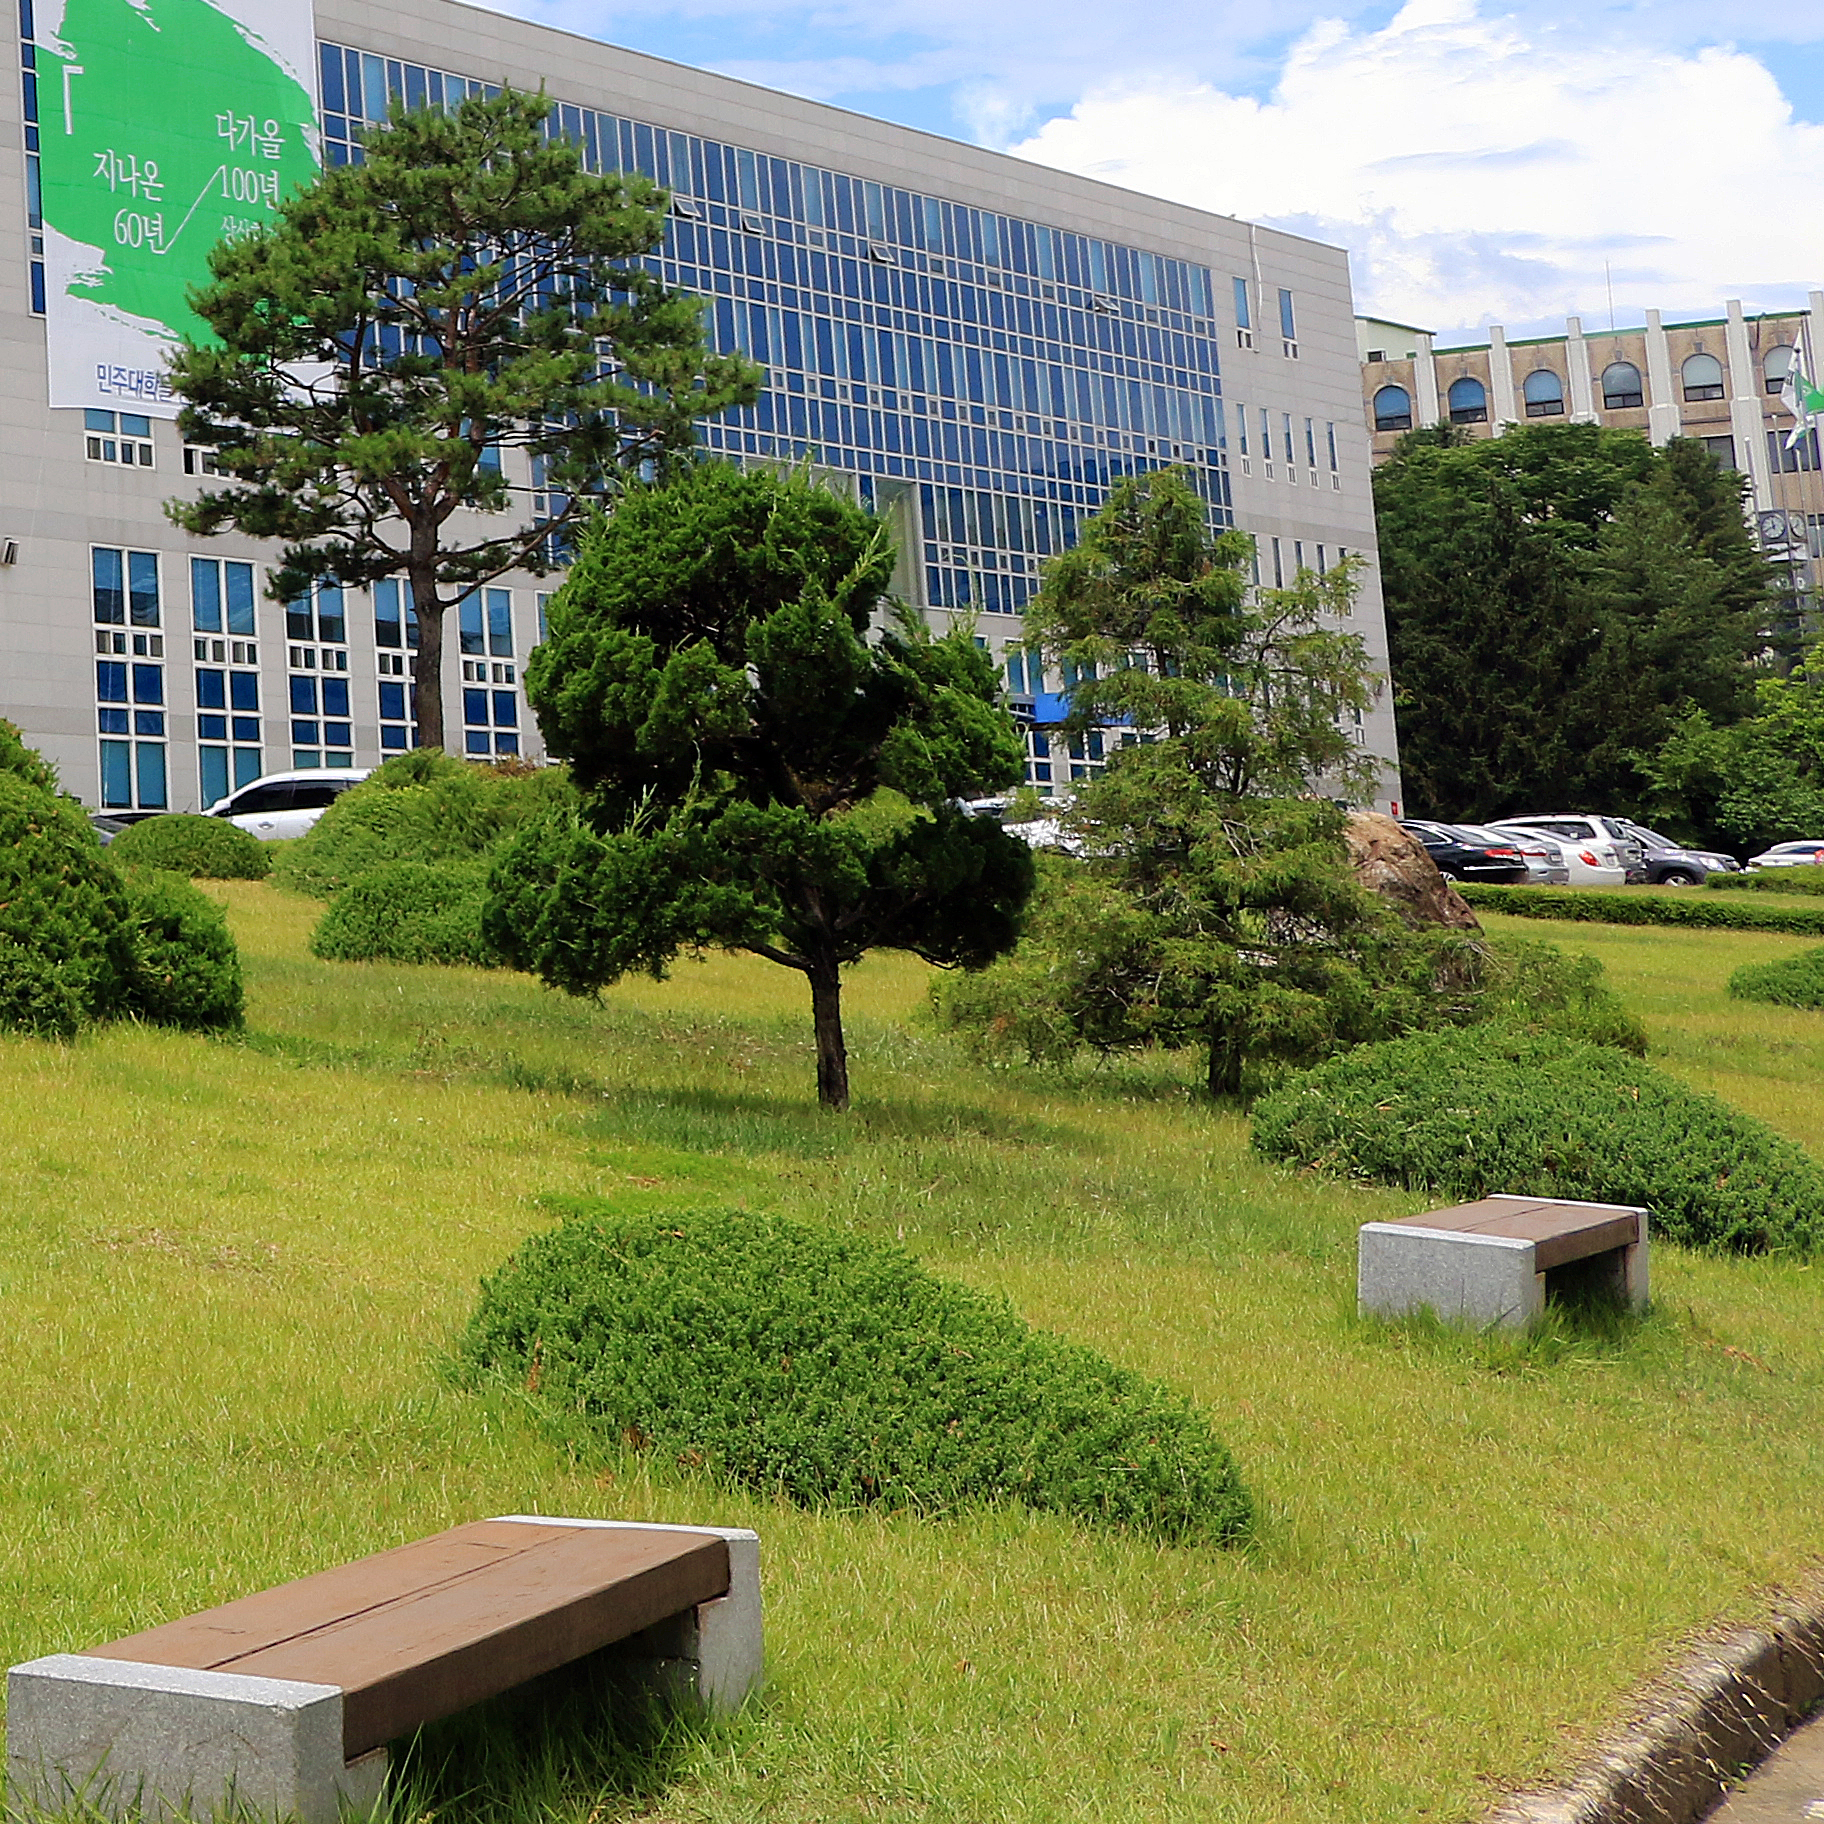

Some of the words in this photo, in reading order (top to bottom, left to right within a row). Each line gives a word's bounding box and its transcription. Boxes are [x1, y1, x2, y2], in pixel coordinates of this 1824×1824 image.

[214, 109, 287, 160] 다가올
[92, 148, 165, 202] 지나온
[219, 164, 280, 211] 100년
[114, 208, 166, 255] 60년
